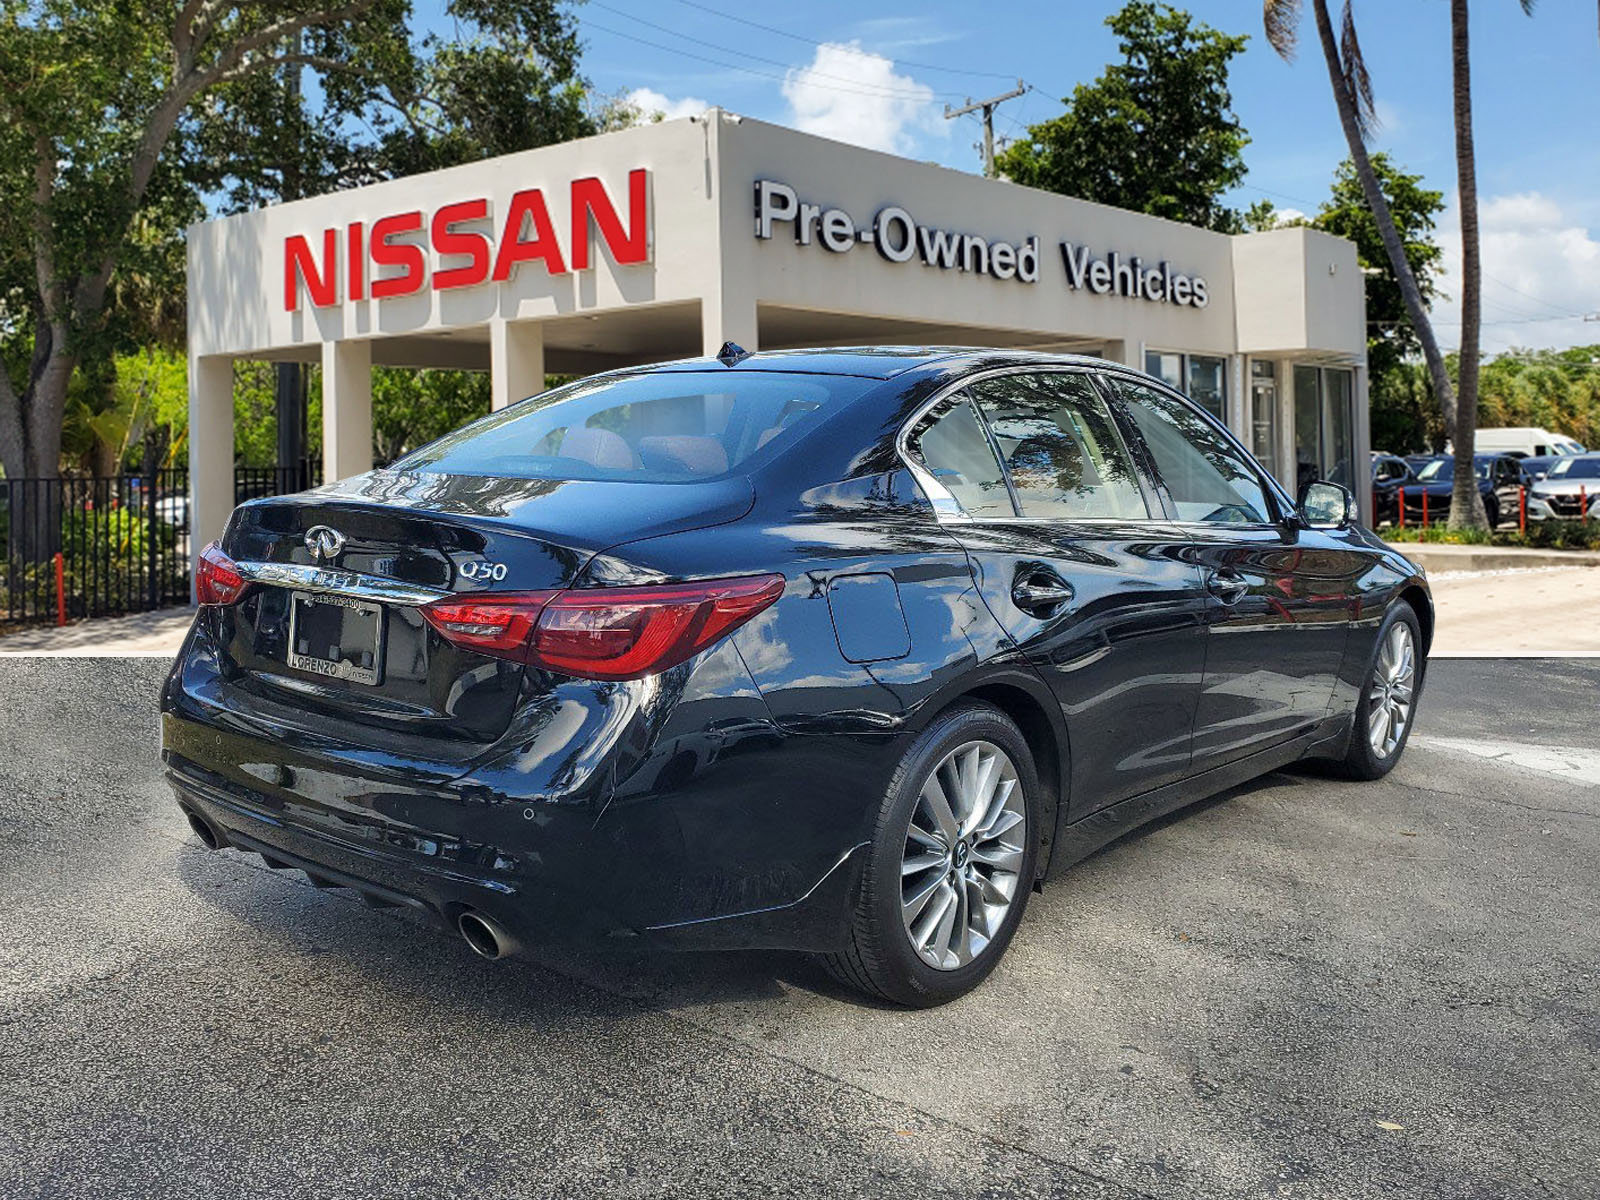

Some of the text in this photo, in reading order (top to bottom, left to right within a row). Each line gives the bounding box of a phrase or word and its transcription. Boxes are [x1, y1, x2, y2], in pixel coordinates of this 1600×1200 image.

[285, 168, 647, 312] NISSAN
[754, 180, 1209, 308] Pre-Owned Vehicles
[459, 561, 507, 582] Q50
[291, 656, 337, 676] LORENZO
